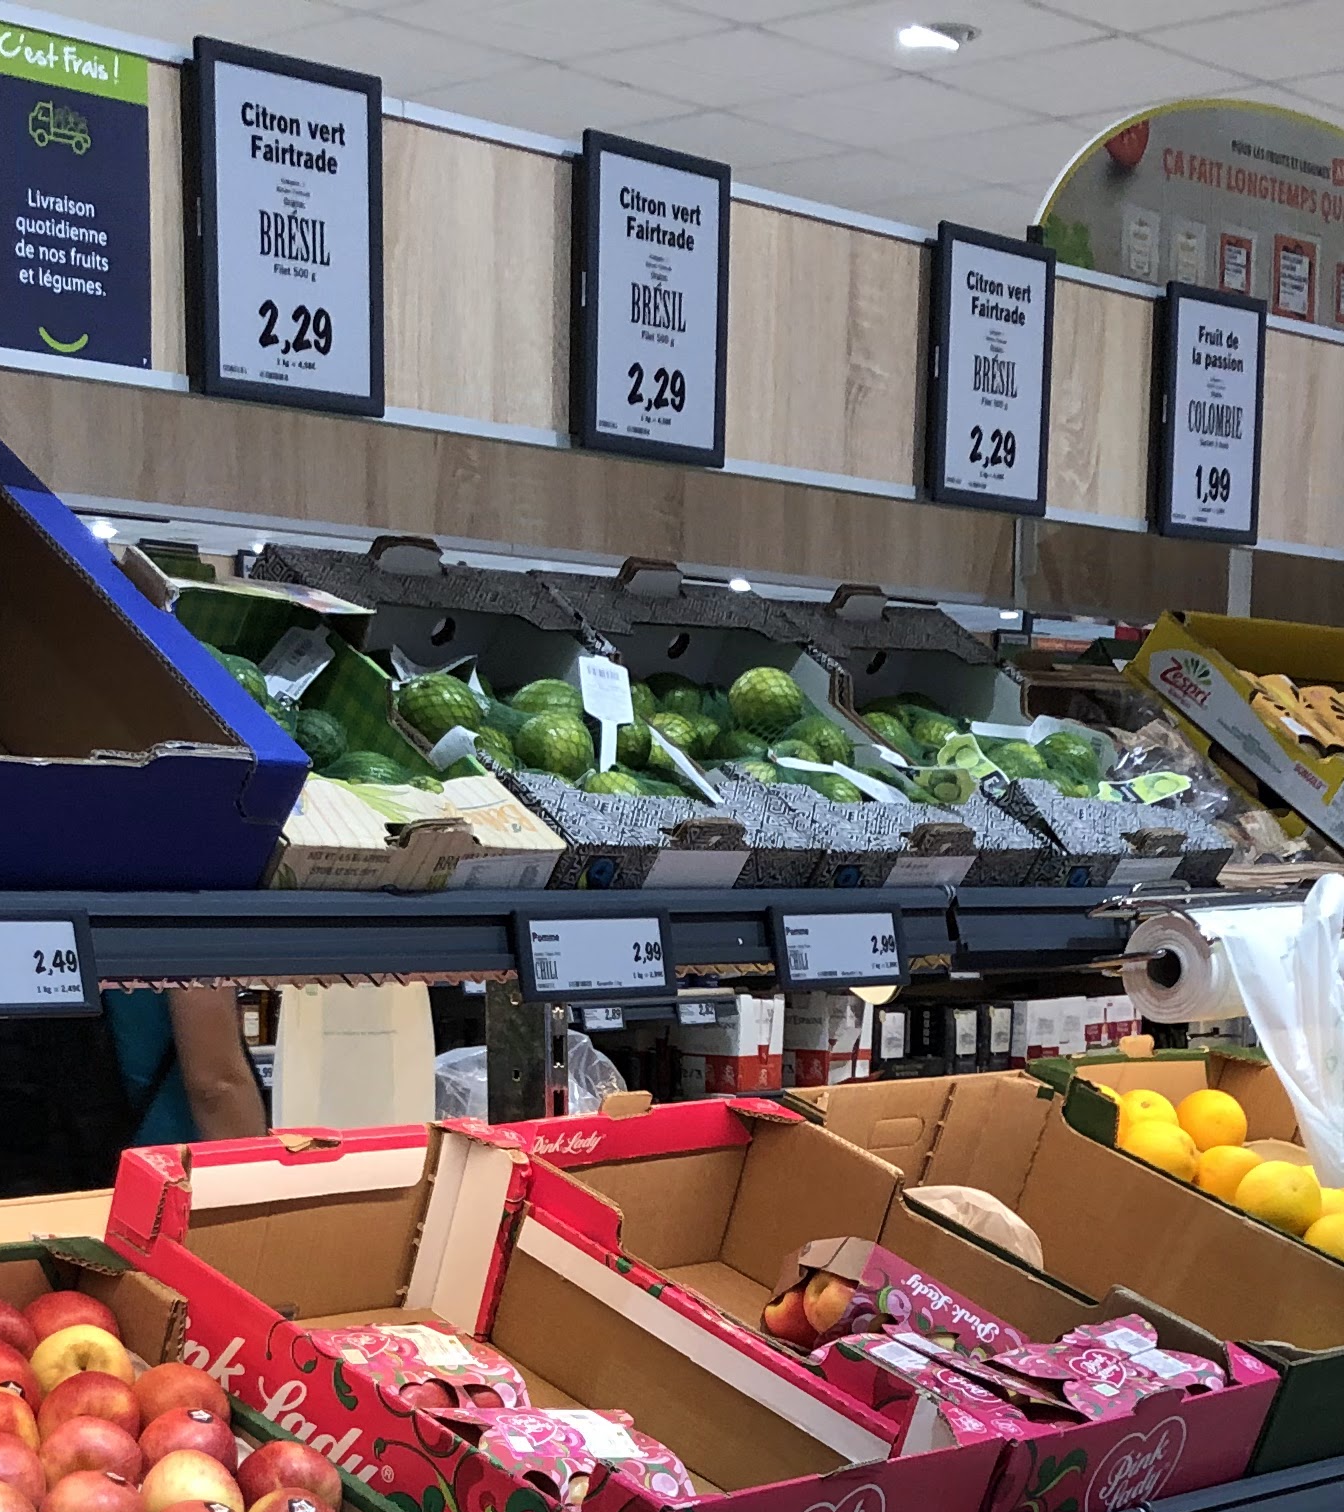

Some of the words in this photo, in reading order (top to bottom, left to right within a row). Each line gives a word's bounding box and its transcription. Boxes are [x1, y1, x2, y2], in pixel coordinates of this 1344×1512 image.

[241, 101, 302, 138] Citron
[308, 120, 346, 149] vert
[250, 134, 338, 176] Fairtrade
[1163, 148, 1184, 181] ÇA
[1188, 155, 1223, 188] FAIT
[1226, 165, 1318, 215] LONGTEMPS
[27, 188, 96, 219] Livraison
[619, 185, 667, 218] Citron
[671, 201, 702, 228] vert
[16, 215, 108, 248] quotidienne
[258, 208, 332, 268] BRÉSIL
[626, 215, 695, 252] Fairtrade
[15, 238, 35, 260] de
[38, 243, 67, 266] nos
[70, 245, 110, 273] fruits
[19, 266, 35, 286] et
[966, 270, 1004, 298] Citron
[1007, 284, 1032, 305] vert
[630, 281, 687, 334] BRÉSIL
[971, 296, 1026, 327] Fairtrade
[257, 299, 334, 357] 2,29
[1198, 324, 1223, 351] Fruit
[1226, 331, 1239, 350] de
[973, 353, 1018, 400] BRÉSIL
[1192, 346, 1202, 366] la
[1205, 352, 1244, 374] passion
[626, 362, 688, 413] 2,29
[1188, 398, 1244, 441] COLOMBIE
[969, 424, 1017, 470] 2,29
[1195, 464, 1232, 504] 1,99
[1159, 655, 1212, 707] Zespri
[532, 930, 559, 943] Pomme
[785, 926, 809, 937] Pomme
[870, 934, 897, 955] 2,99
[33, 949, 79, 976] 2,49
[632, 941, 661, 963] 2,99
[531, 1134, 564, 1158] Pink
[563, 1130, 602, 1155] Lady
[905, 1273, 953, 1312] Lady
[952, 1304, 1000, 1344] Pink
[1098, 1430, 1171, 1499] Pink
[1105, 1470, 1162, 1512] Lady
